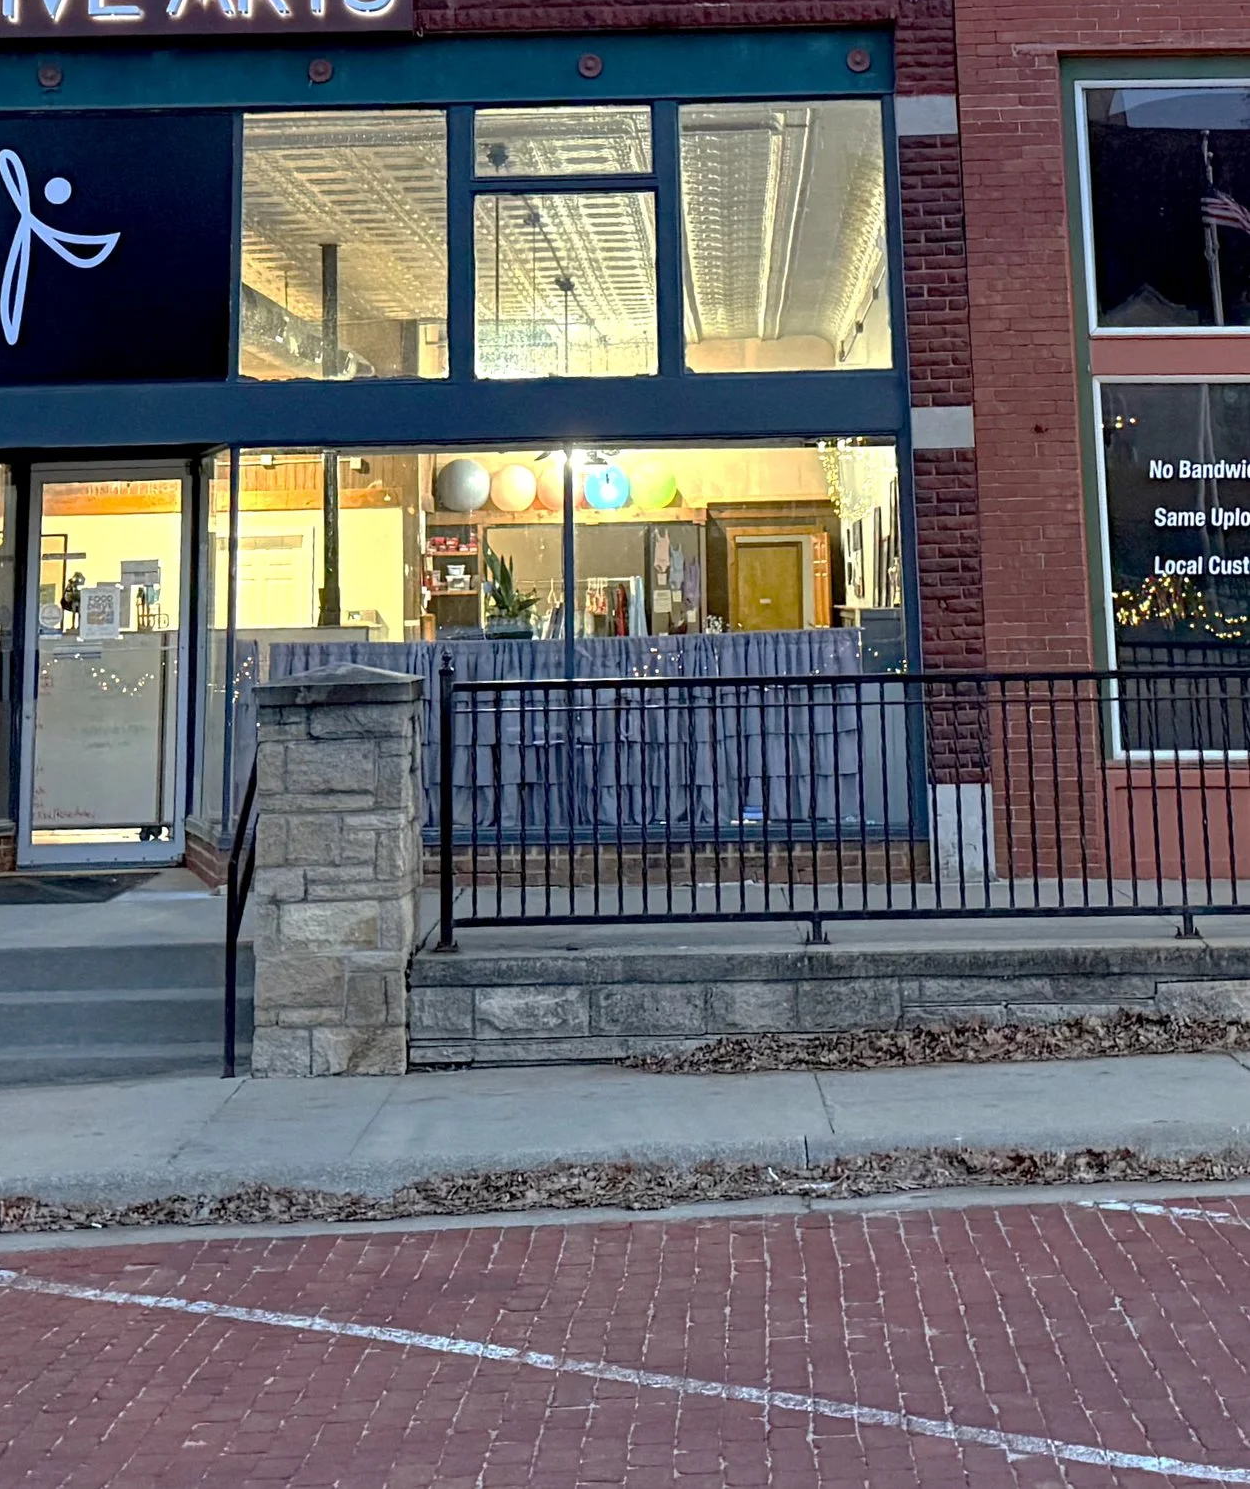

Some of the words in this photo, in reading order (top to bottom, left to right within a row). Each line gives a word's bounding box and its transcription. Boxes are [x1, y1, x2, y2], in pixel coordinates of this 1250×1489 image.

[1149, 460, 1173, 479] No
[1154, 507, 1206, 527] Same
[1211, 507, 1250, 530] Uplo
[1154, 556, 1203, 575] Local
[1208, 556, 1250, 575] Cust
